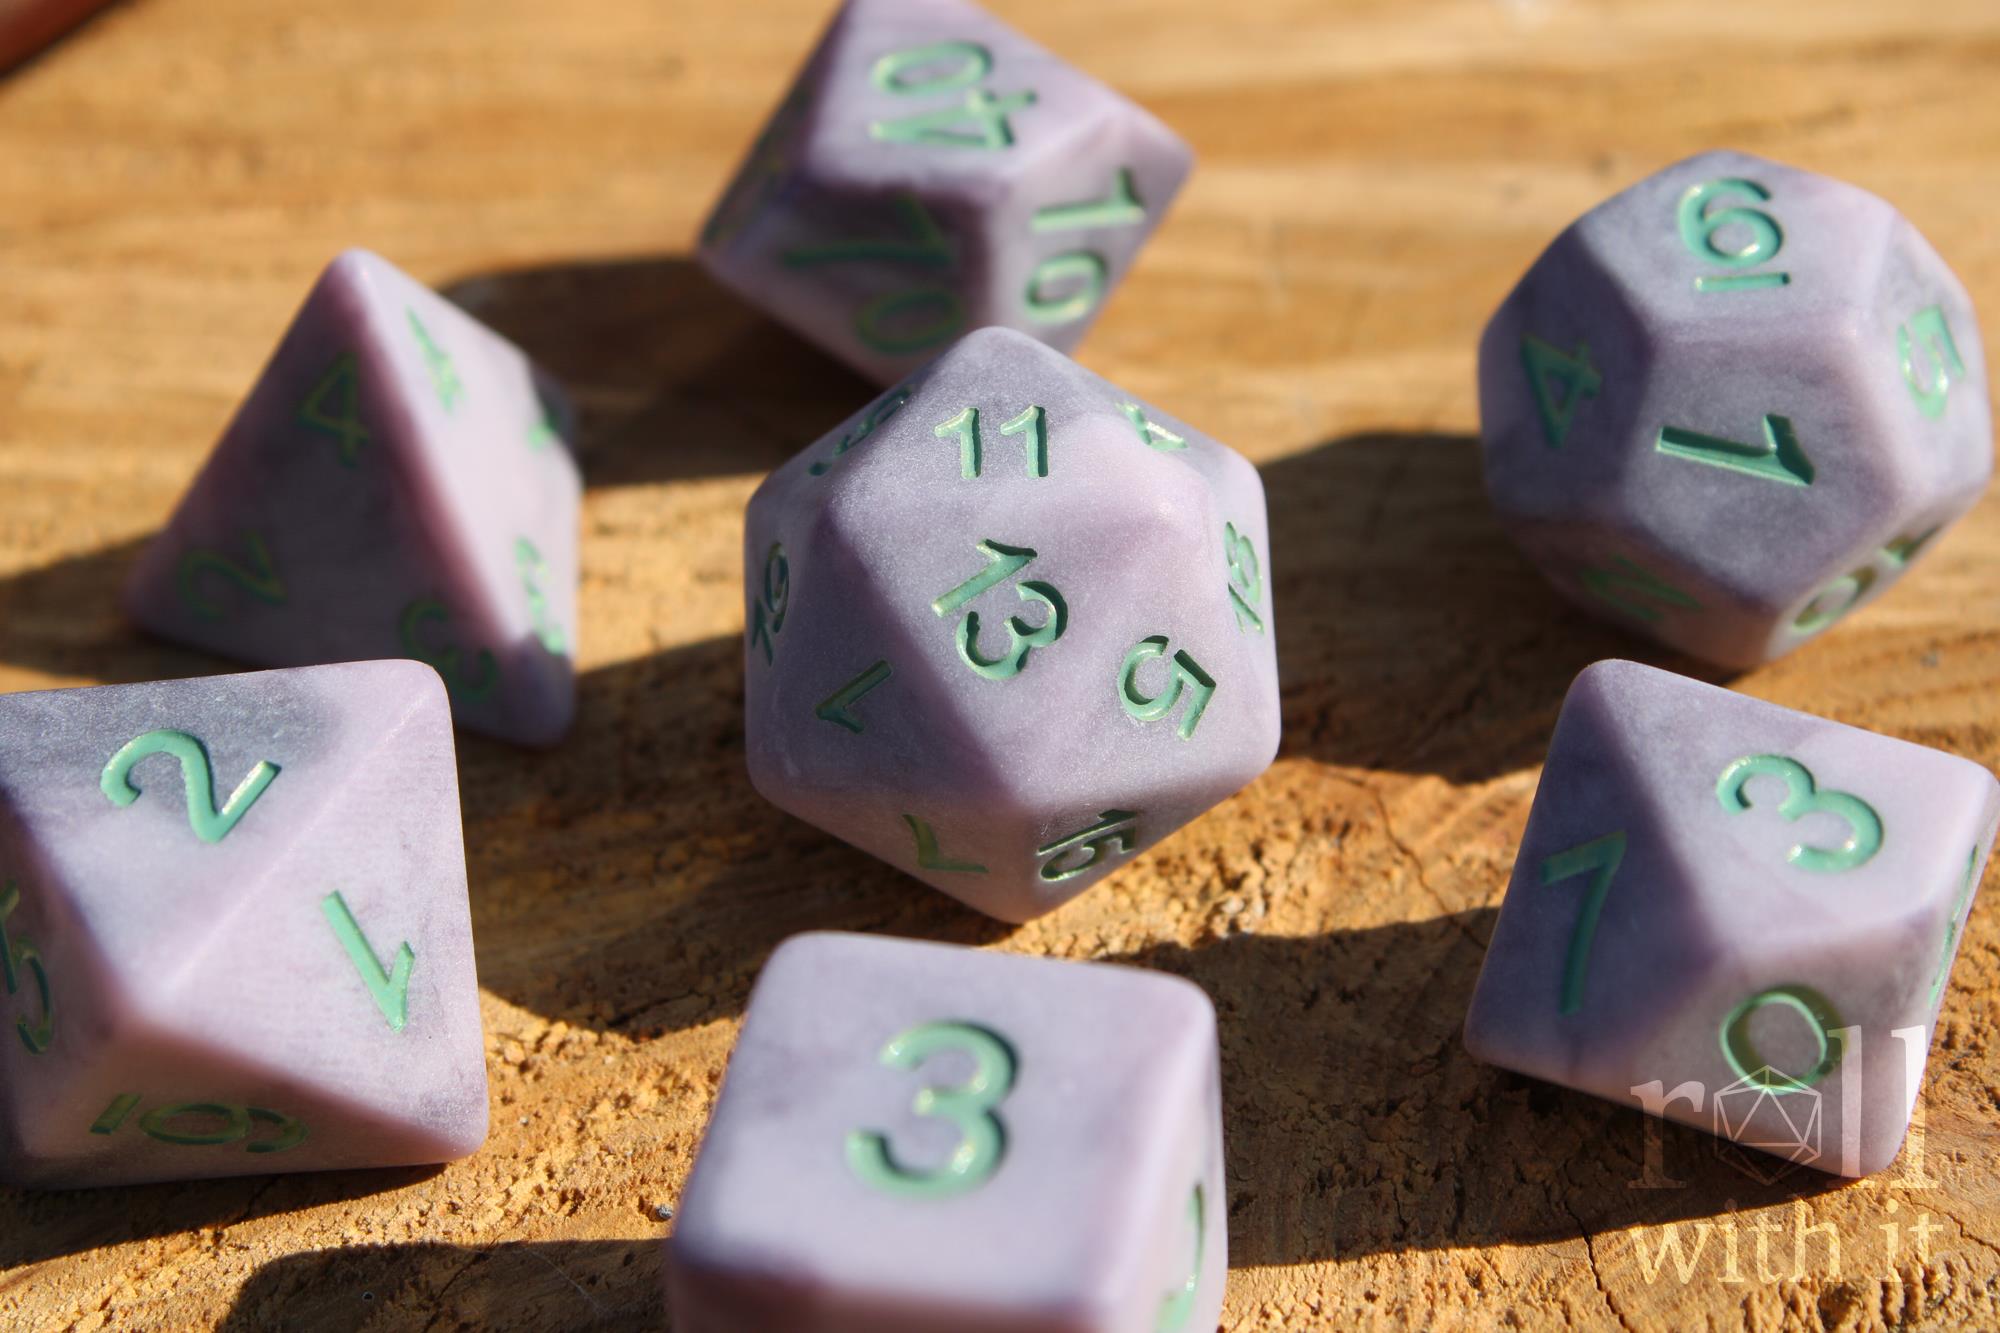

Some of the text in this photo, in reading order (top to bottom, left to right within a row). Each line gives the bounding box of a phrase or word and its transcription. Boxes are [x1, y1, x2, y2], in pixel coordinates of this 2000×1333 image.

[869, 40, 1038, 150] 40
[298, 350, 369, 468] 4
[1521, 334, 1603, 450] 4
[1897, 305, 1966, 421] 5
[934, 405, 1048, 480] 11
[1655, 413, 1816, 487] 1
[178, 528, 289, 622] 2
[931, 538, 1069, 681] 13
[815, 658, 894, 735] 1
[1118, 634, 1217, 743] 5
[101, 729, 282, 844] 2
[1715, 754, 1884, 875] 3
[903, 813, 990, 874] 7
[1036, 809, 1138, 882] 15
[320, 889, 416, 1034] 1
[1540, 830, 1627, 1016] 7
[1719, 984, 1849, 1096] 0
[845, 1018, 1020, 1196] 3
